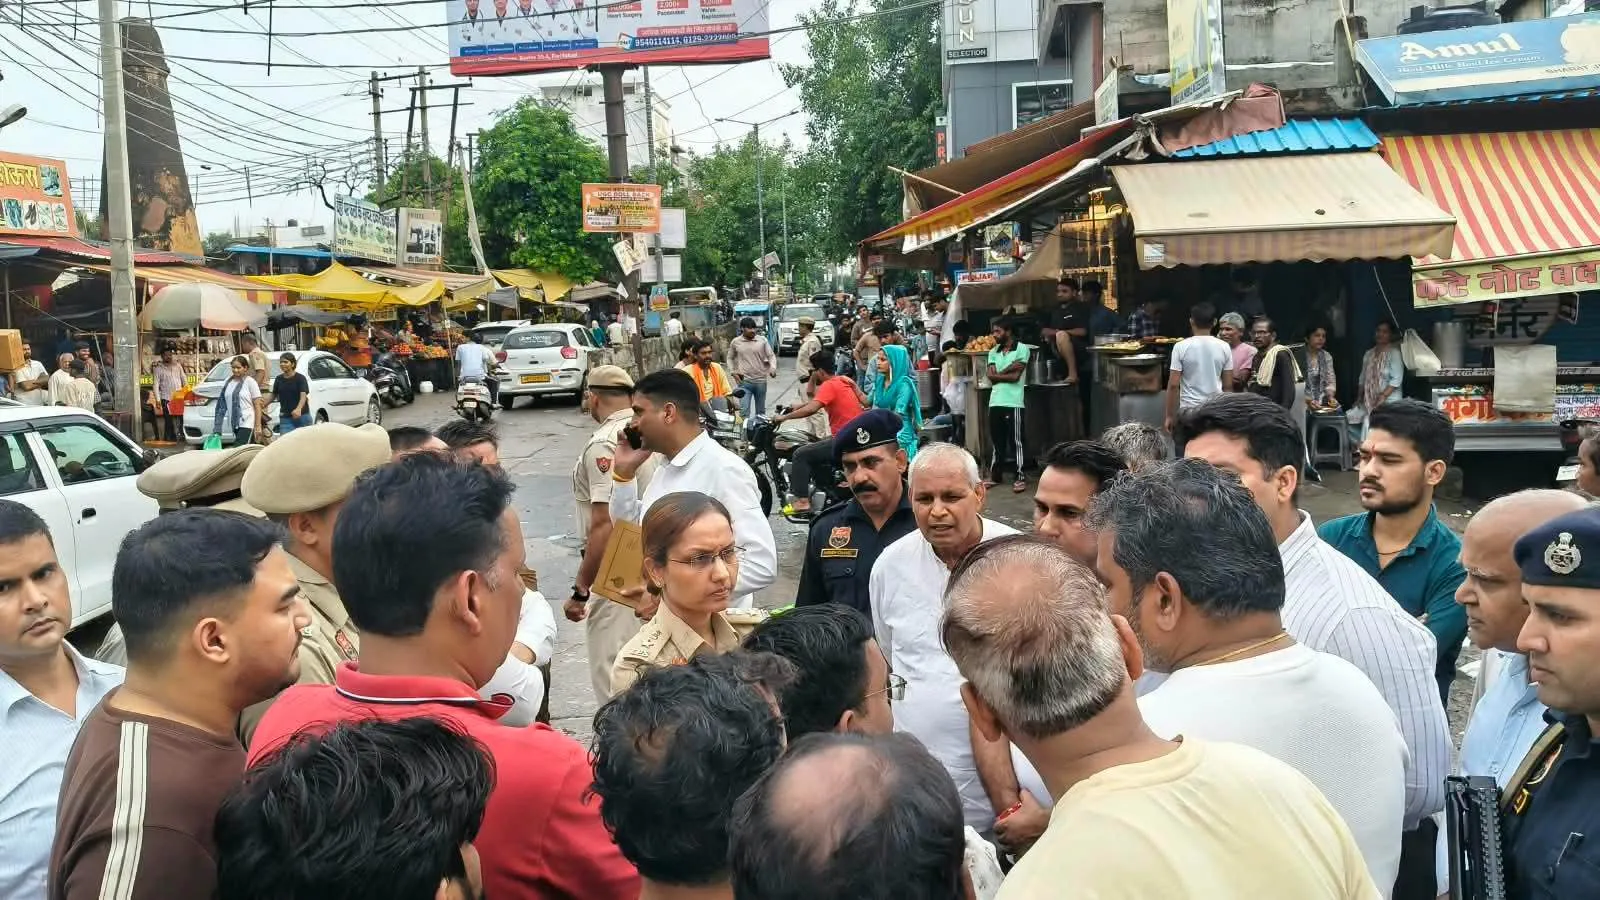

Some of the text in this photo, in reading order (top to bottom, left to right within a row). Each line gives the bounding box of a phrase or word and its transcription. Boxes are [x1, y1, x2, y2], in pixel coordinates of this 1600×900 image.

[947, 49, 986, 58] SELECTION
[1400, 33, 1522, 63] Amul
[1477, 264, 1542, 294] नोट
